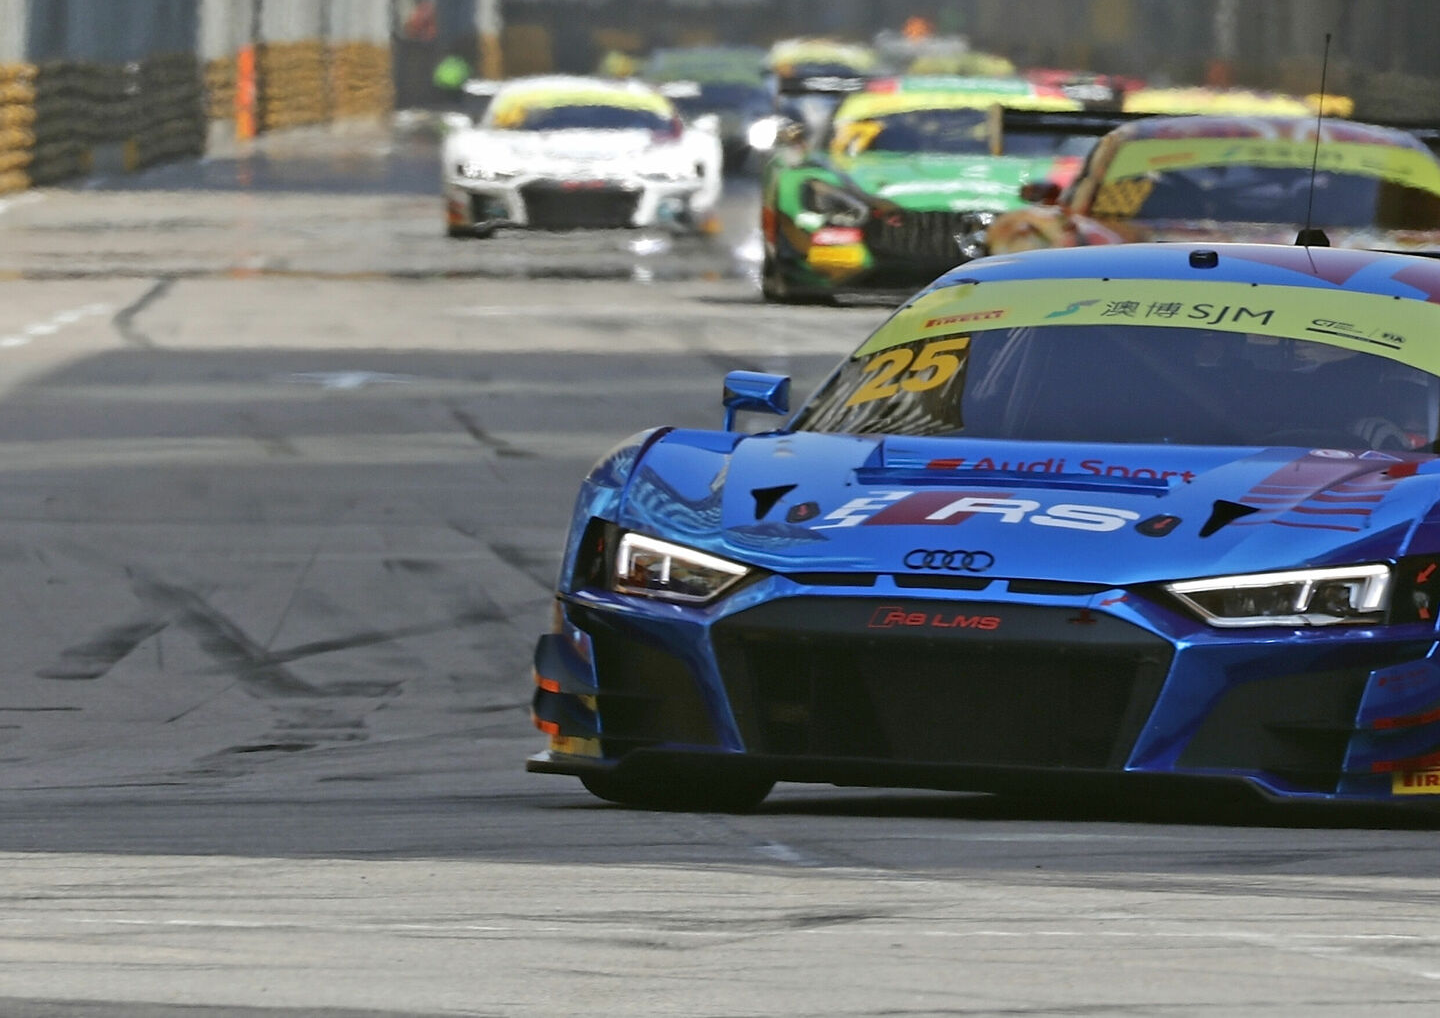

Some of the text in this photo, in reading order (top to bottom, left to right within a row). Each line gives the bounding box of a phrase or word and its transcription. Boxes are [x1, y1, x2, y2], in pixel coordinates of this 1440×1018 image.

[1101, 300, 1275, 325] 澳博 SJM
[846, 336, 970, 407] 25
[971, 457, 1066, 475] Audi
[924, 496, 1140, 532] RS
[883, 611, 1001, 631] R8 LMS
